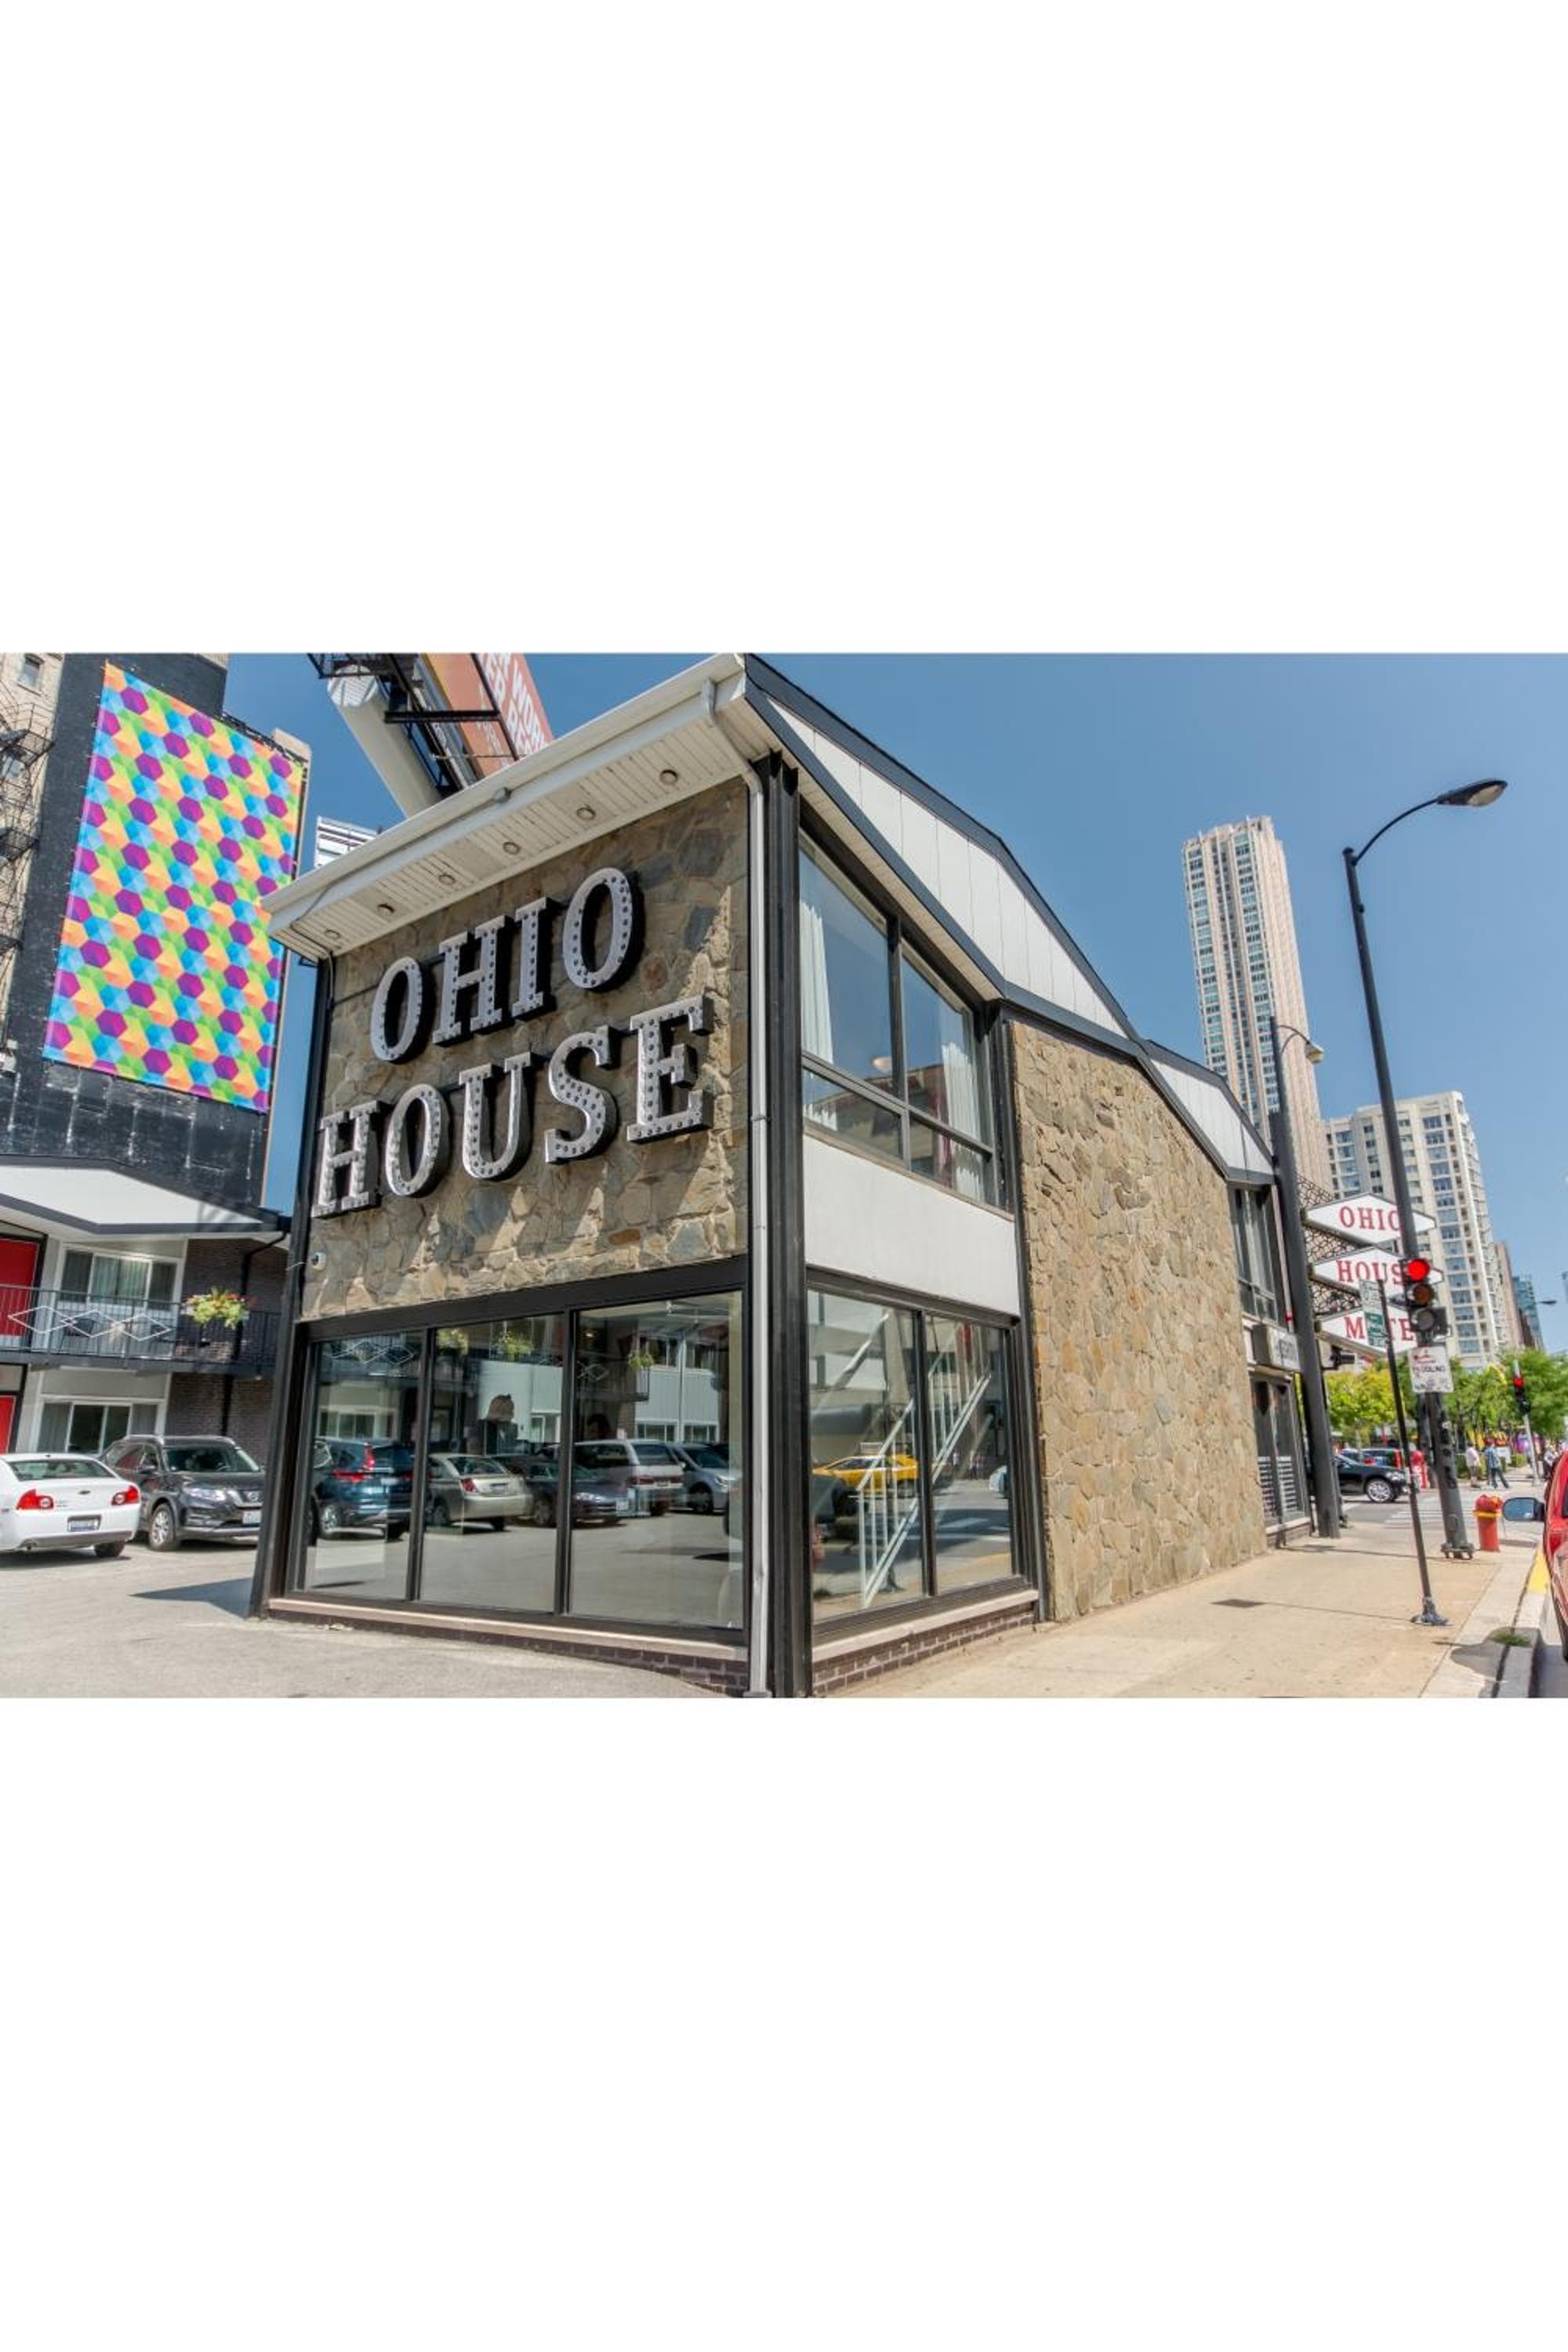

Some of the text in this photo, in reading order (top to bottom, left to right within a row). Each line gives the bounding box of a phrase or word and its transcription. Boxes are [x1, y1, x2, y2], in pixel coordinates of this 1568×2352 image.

[369, 867, 635, 1061] OHIO
[311, 994, 712, 1217] HOUSE
[1337, 1259, 1406, 1283] HOUS
